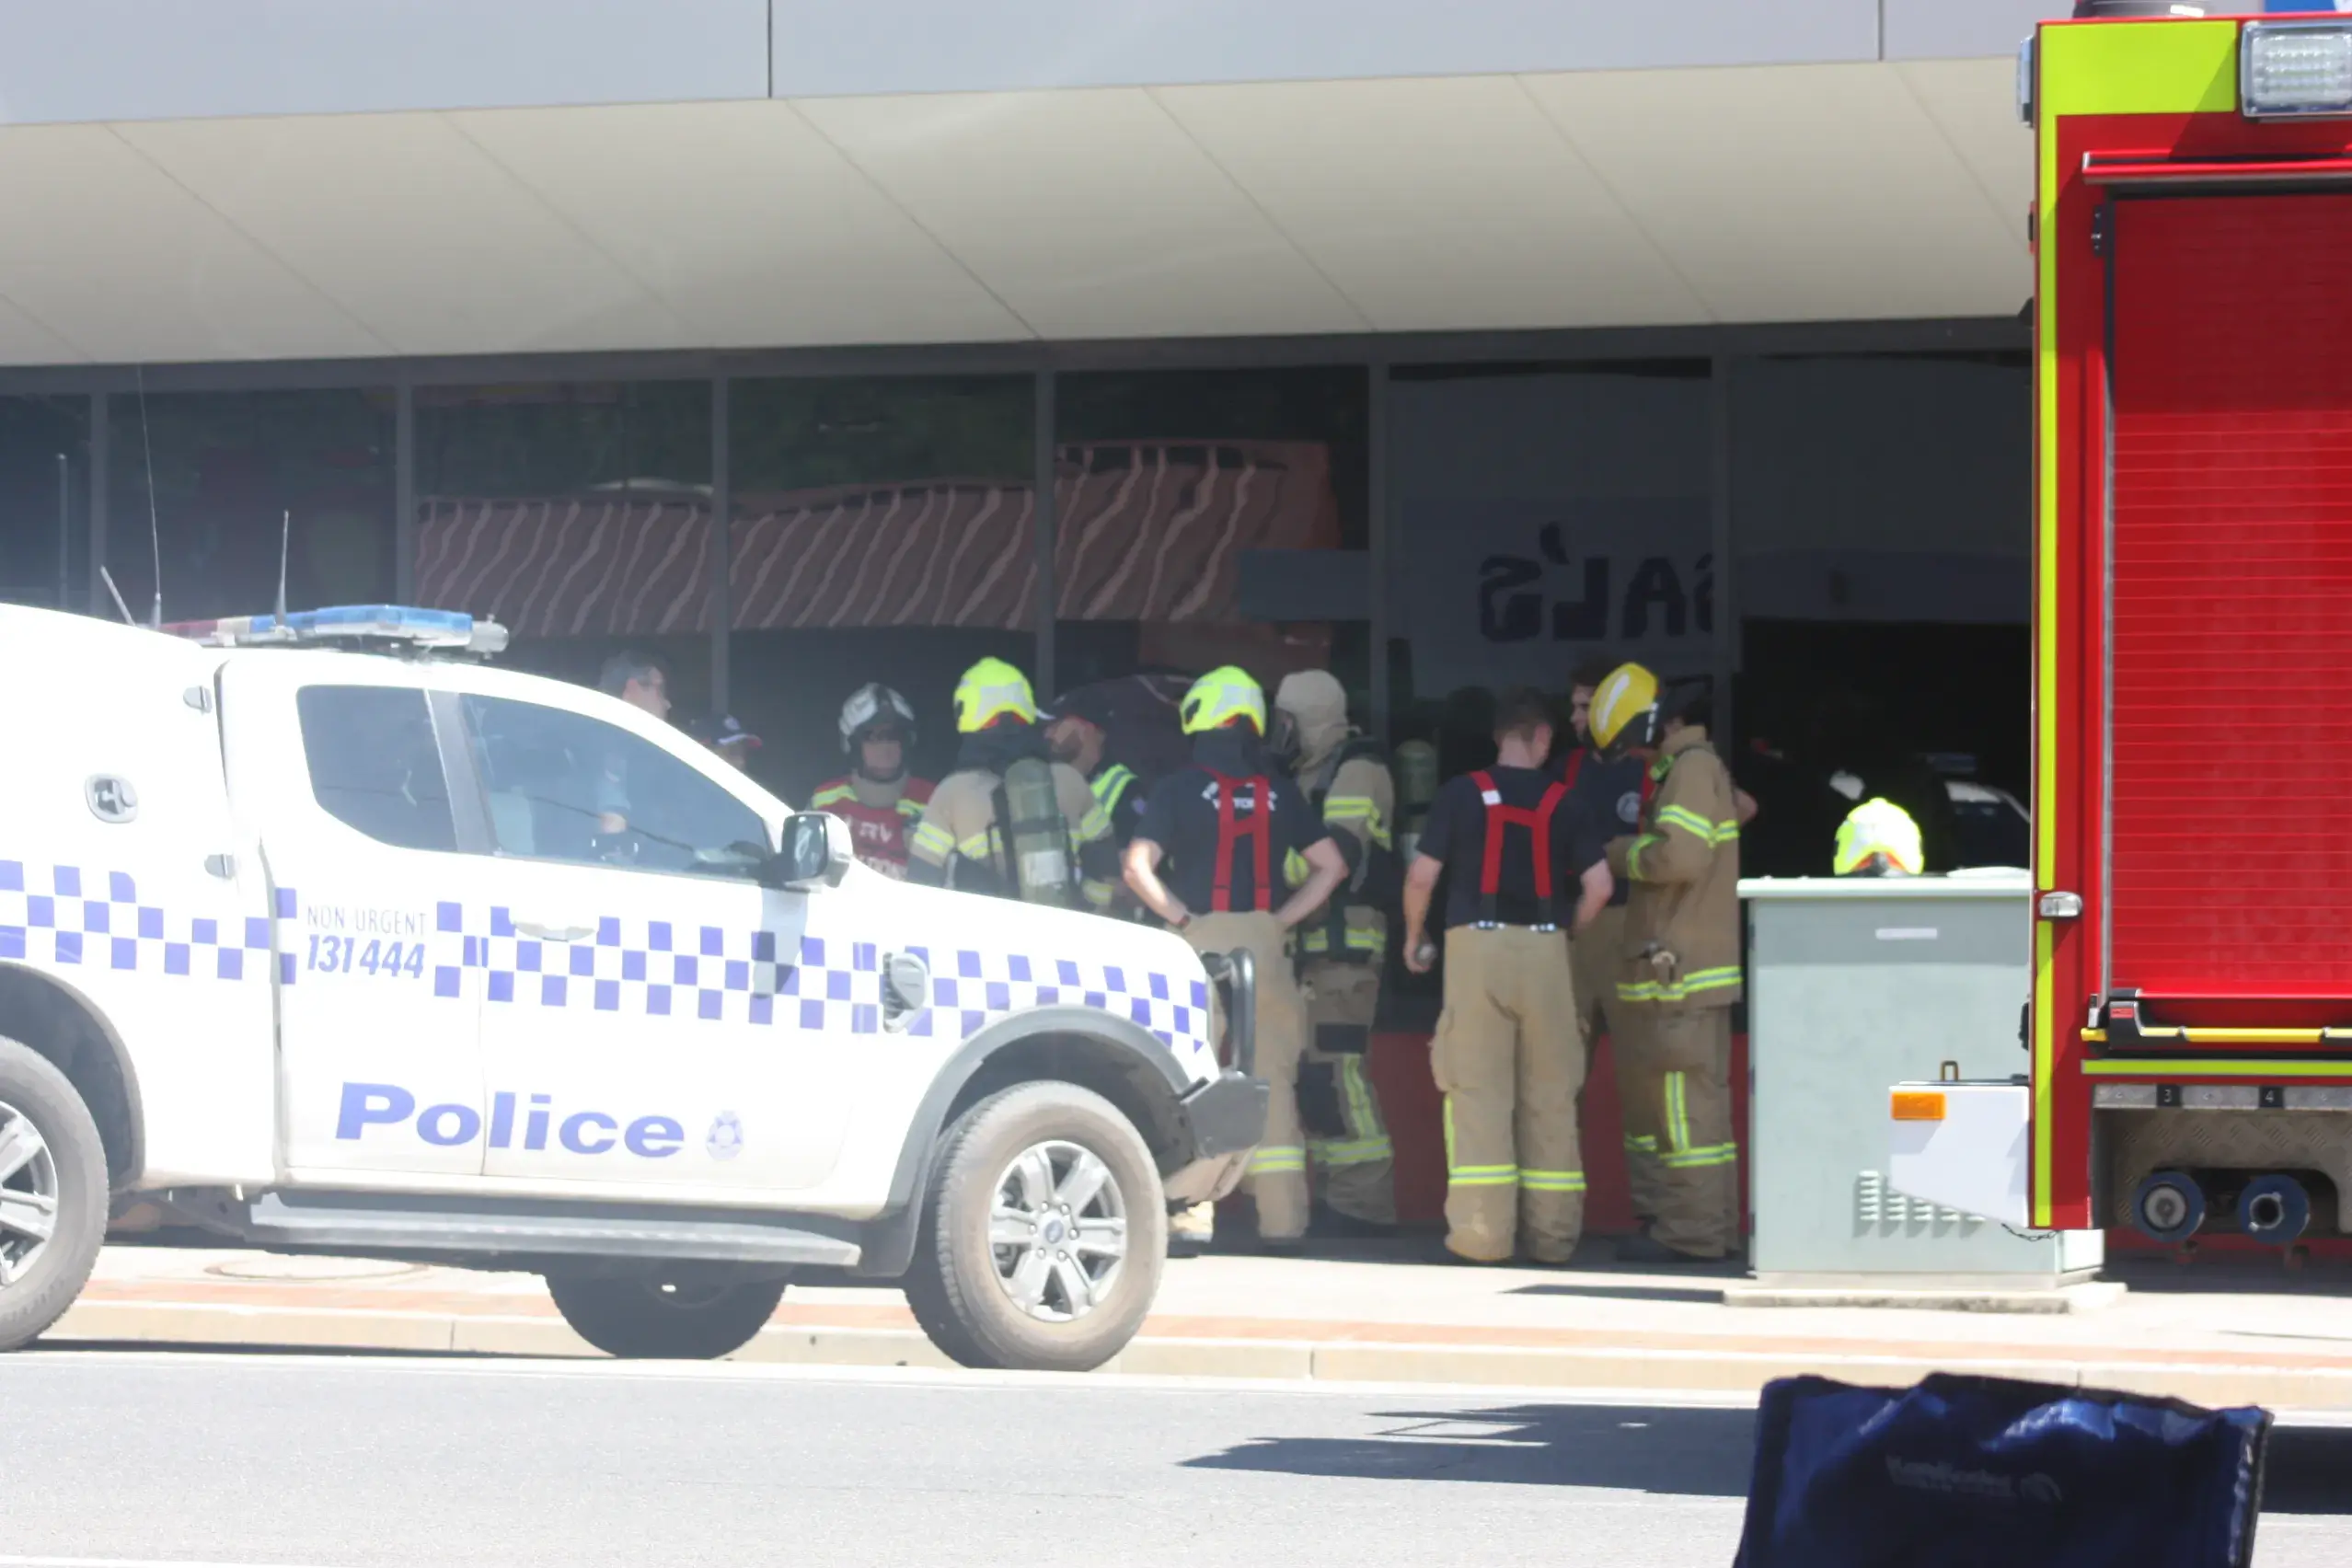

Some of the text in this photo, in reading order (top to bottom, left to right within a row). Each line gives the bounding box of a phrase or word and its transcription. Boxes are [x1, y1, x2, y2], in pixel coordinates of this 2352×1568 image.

[307, 905, 427, 936] NON URGENT
[307, 933, 426, 979] 131 444
[2163, 1089, 2173, 1102] 3
[2265, 1090, 2275, 1103] 4
[335, 1081, 686, 1159] Police
